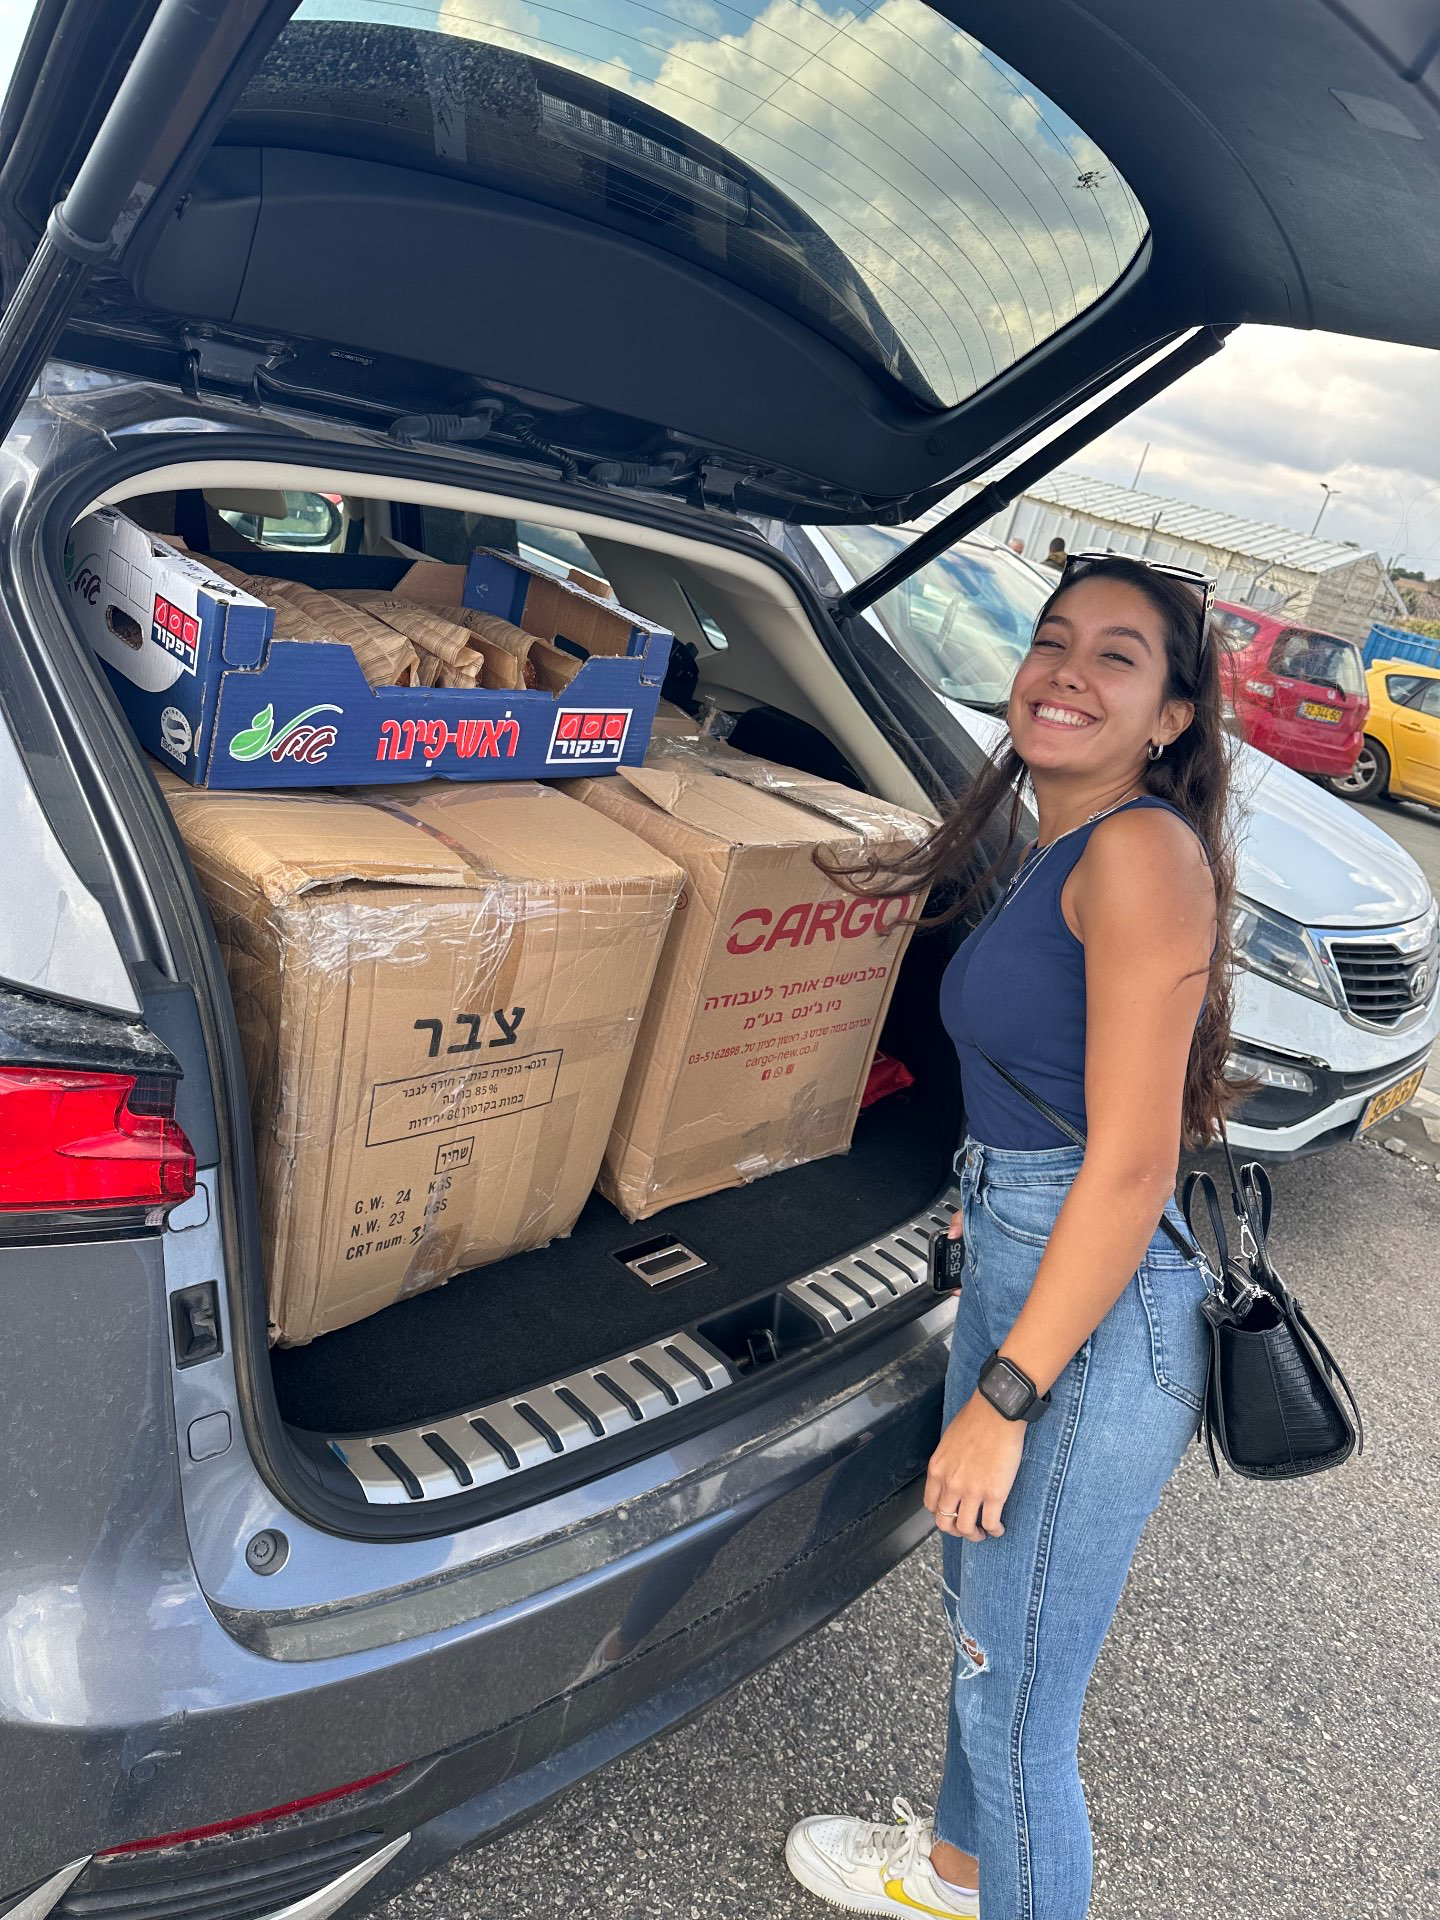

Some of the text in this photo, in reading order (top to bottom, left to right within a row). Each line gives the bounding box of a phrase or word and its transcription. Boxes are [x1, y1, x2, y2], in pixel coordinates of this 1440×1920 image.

[153, 622, 195, 664] רפקור
[555, 739, 619, 758] רפקור
[726, 895, 911, 955] CARGO
[703, 966, 887, 1011] מלבישים אותך לעבודה
[826, 999, 842, 1013] ניו
[413, 1006, 526, 1058] צבר
[848, 1017, 872, 1030] אברהם
[757, 1037, 776, 1052] לציון
[777, 1033, 800, 1048] ראשון
[688, 1045, 741, 1065] 03-5162898
[745, 1041, 820, 1067] cargo-new.co.il
[458, 1071, 488, 1085] כותה
[491, 1065, 522, 1078] גופיית
[402, 1083, 427, 1098] לגבר
[475, 1083, 498, 1096] 85%
[462, 1099, 497, 1118] בקרטון
[498, 1093, 524, 1108] כמות
[396, 1188, 411, 1205] 24
[388, 1211, 405, 1227] 23
[345, 1241, 373, 1261] CRT
[375, 1235, 406, 1252] num:
[950, 1243, 962, 1277] 15:35
